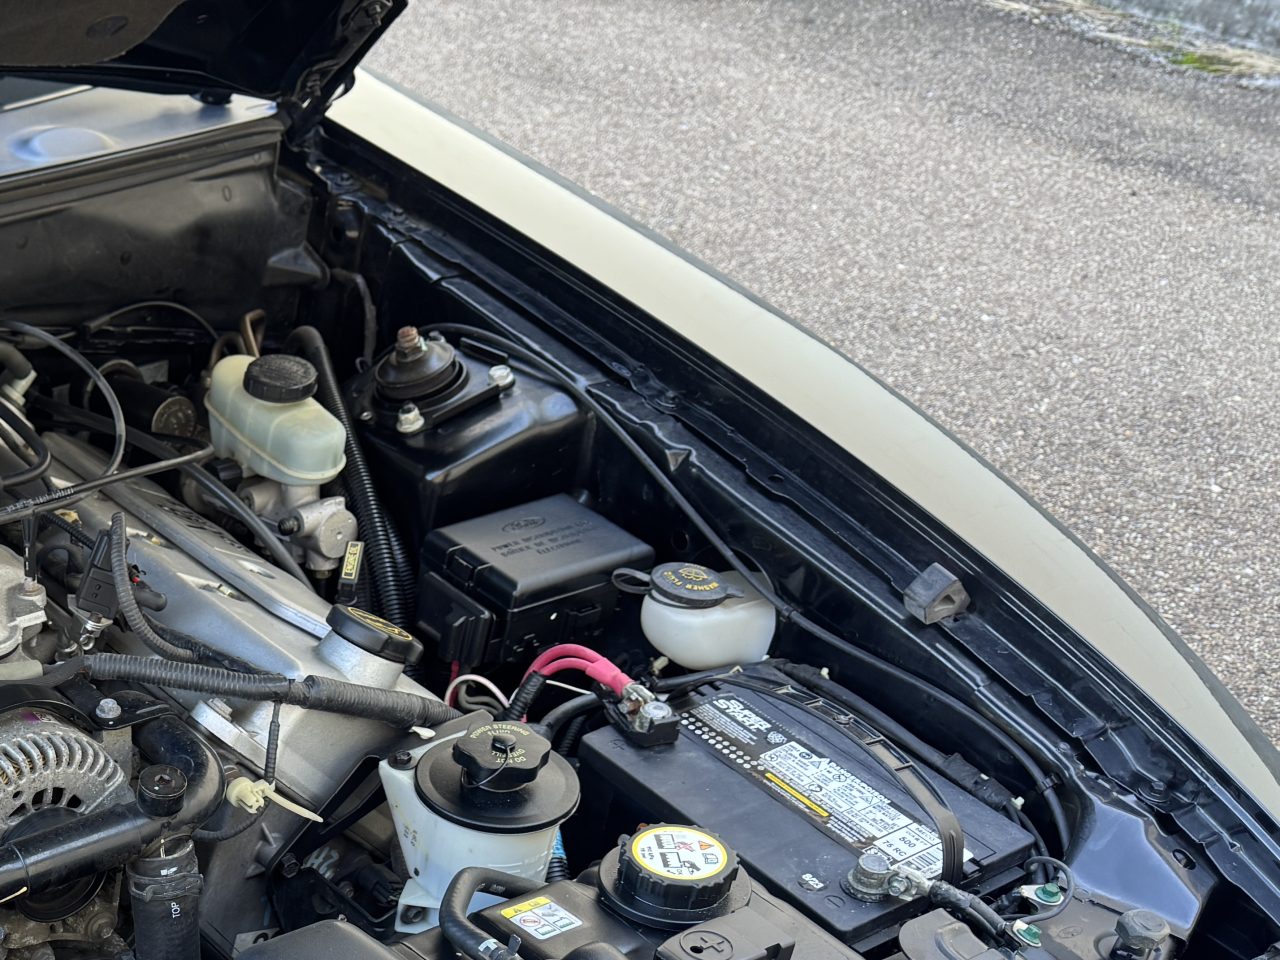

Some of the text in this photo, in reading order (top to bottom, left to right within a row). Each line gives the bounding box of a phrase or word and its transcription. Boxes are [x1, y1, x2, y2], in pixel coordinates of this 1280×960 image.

[714, 700, 762, 732] START
[726, 699, 772, 729] SUPER
[470, 724, 530, 739] POWER STEERING
[899, 836, 916, 848] 500
[171, 902, 181, 918] TOP
